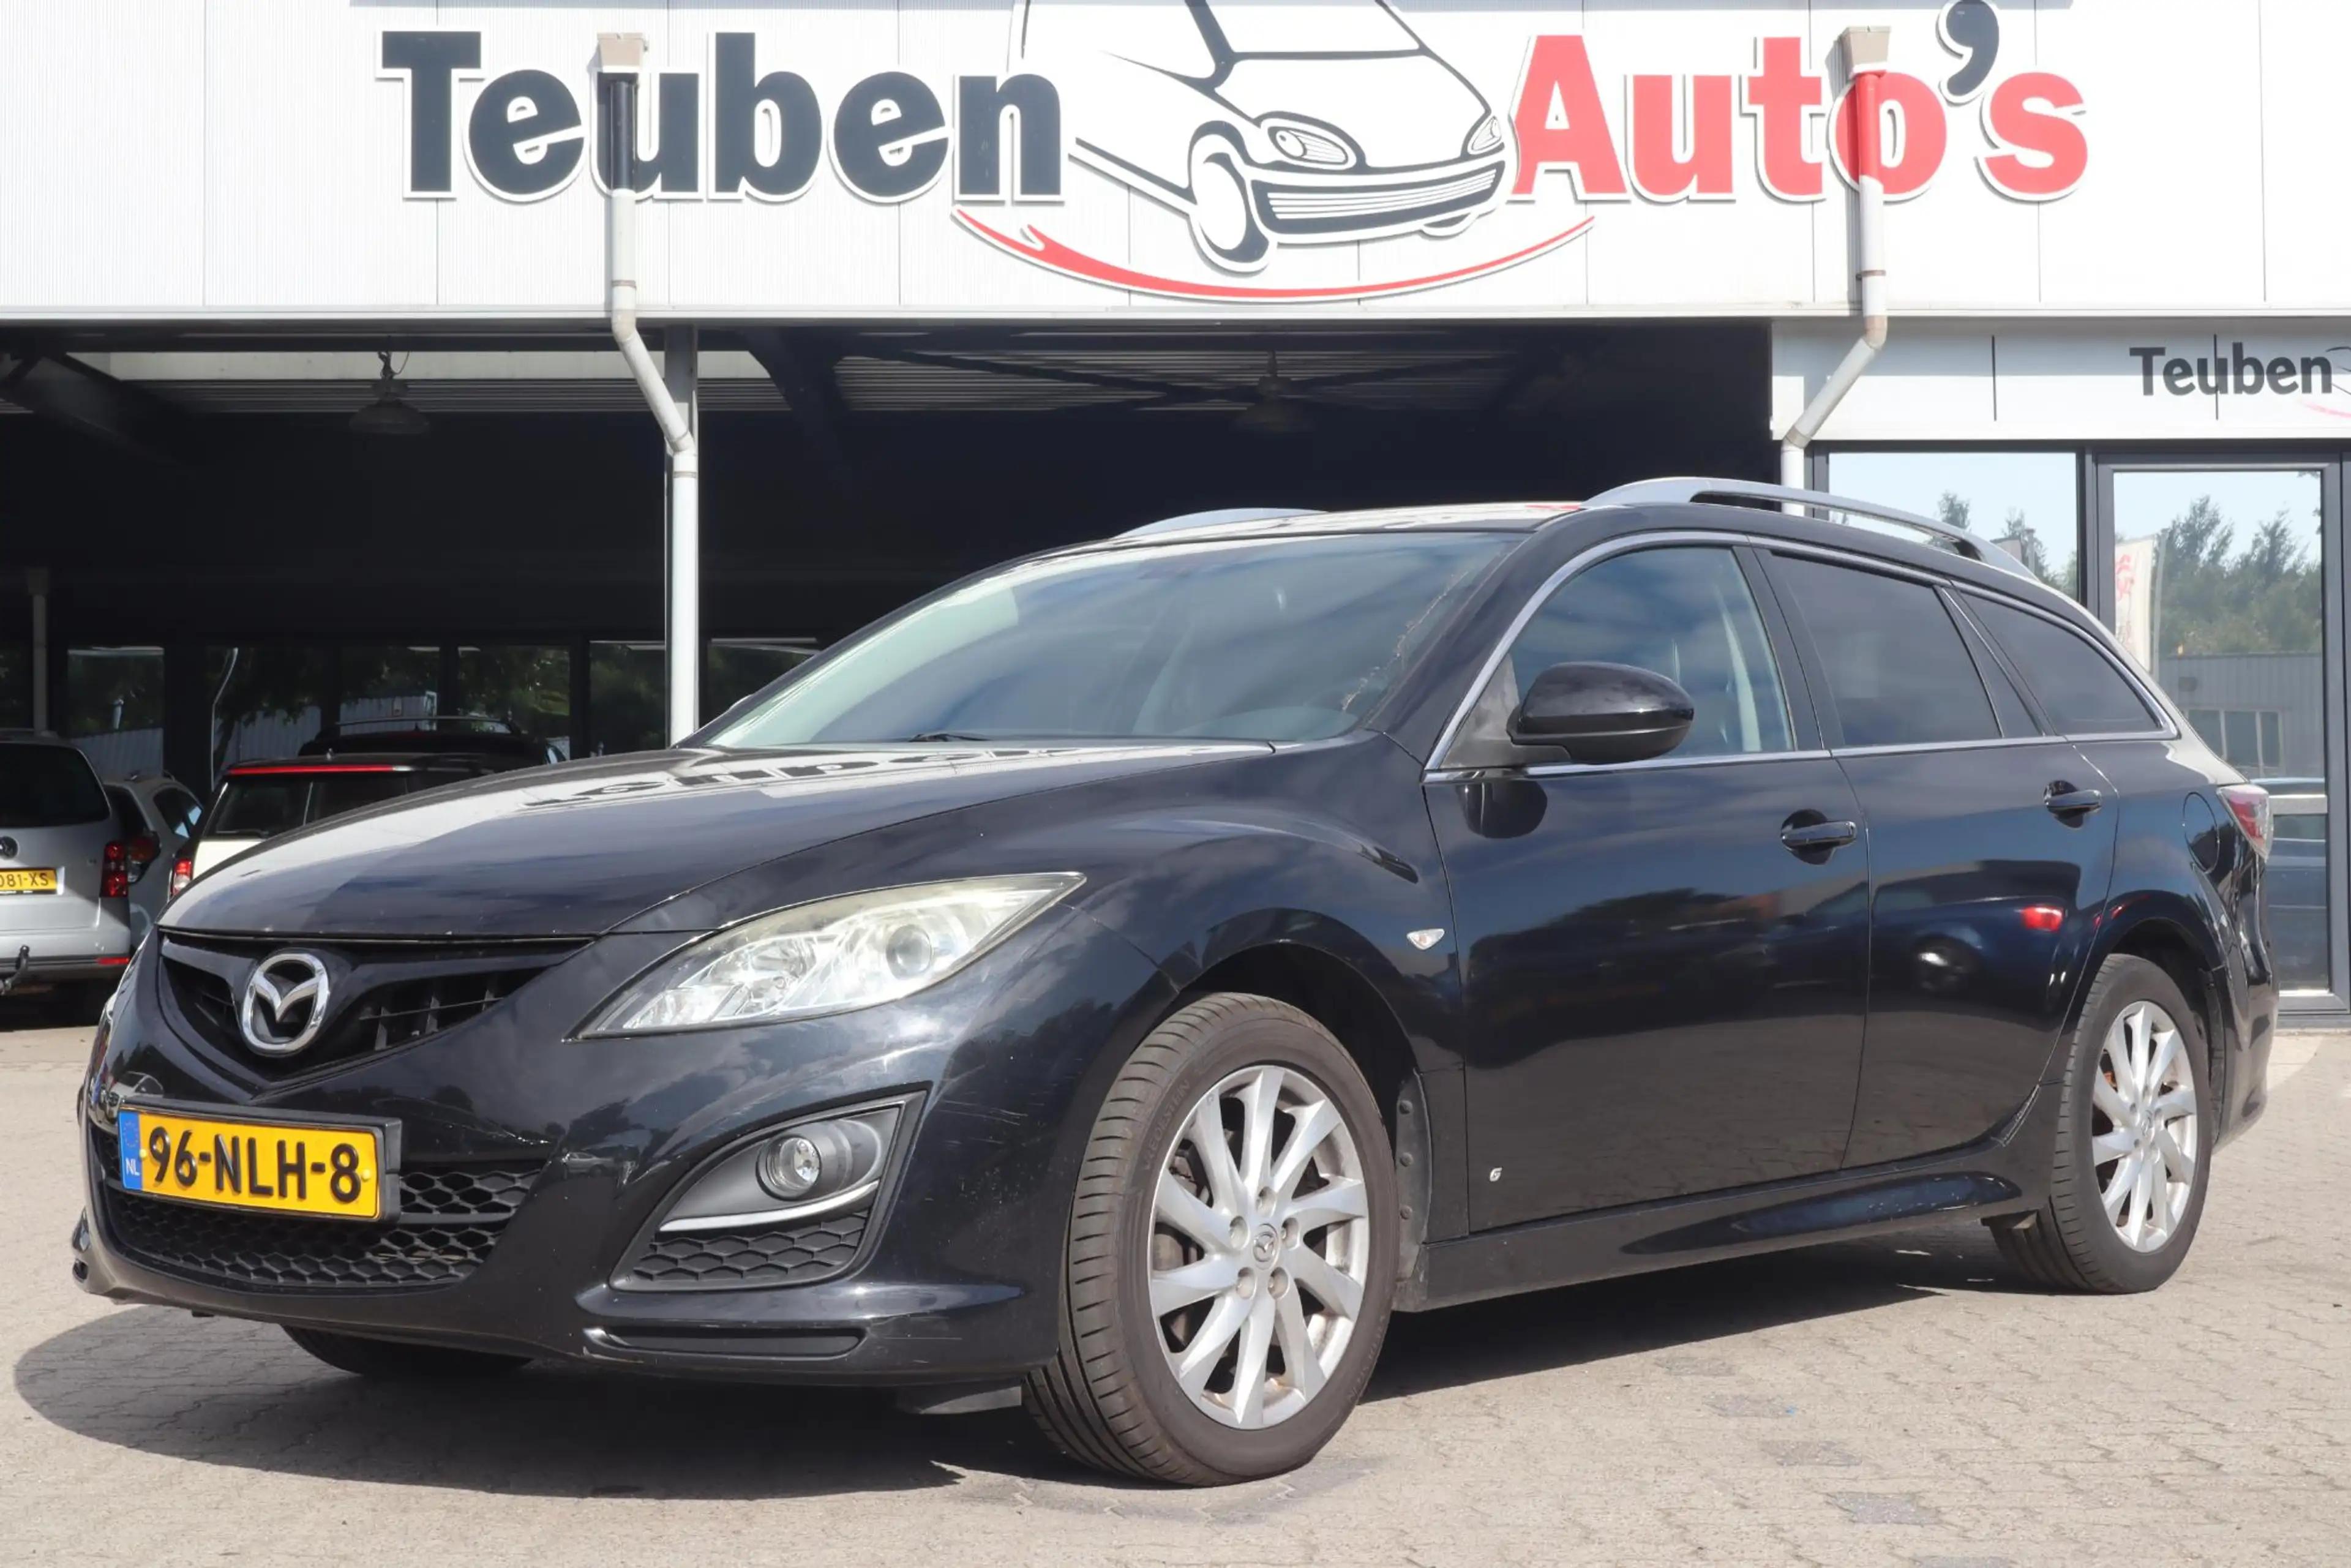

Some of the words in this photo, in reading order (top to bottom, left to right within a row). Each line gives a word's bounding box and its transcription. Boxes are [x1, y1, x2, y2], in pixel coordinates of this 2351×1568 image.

[381, 29, 1063, 203] Teuben
[1511, 0, 2088, 197] Auto's
[2129, 341, 2333, 396] Teuben
[125, 1157, 140, 1176] NL
[148, 1126, 361, 1204] 96-NLH-8
